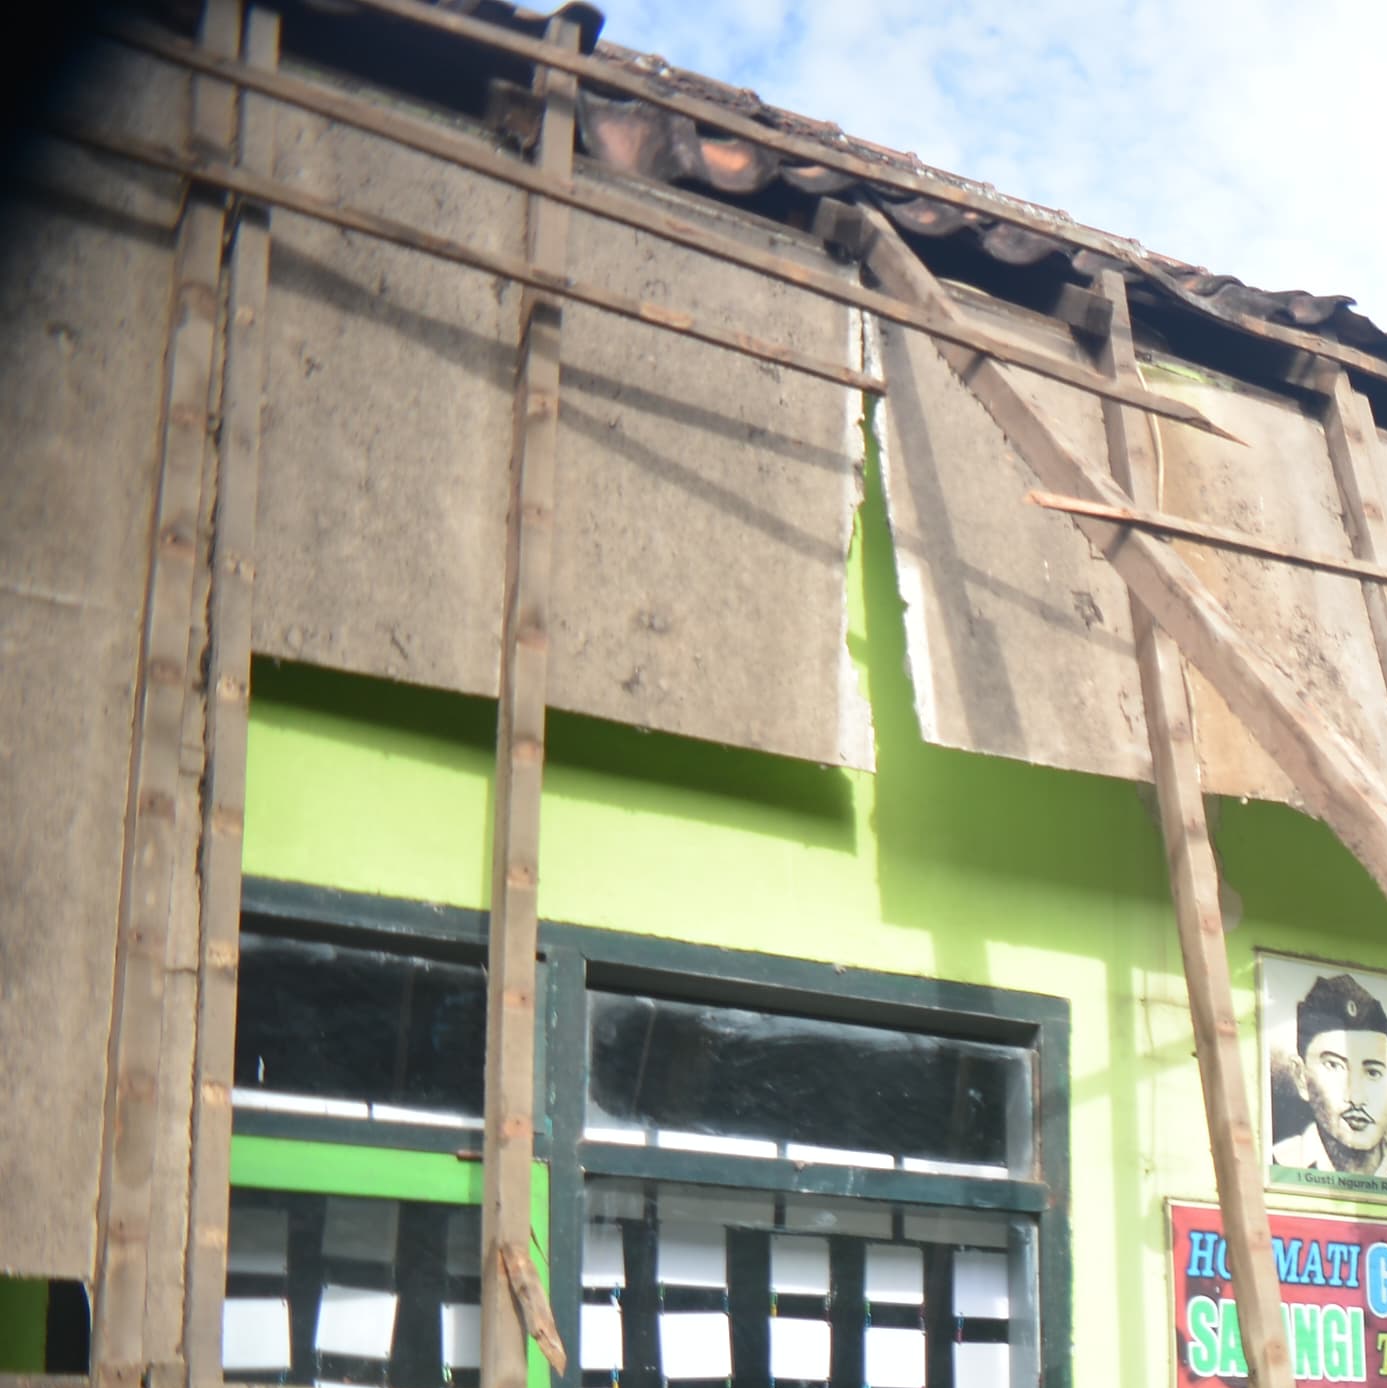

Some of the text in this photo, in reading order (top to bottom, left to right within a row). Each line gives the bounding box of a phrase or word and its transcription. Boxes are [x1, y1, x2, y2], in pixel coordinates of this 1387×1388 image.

[1305, 1172, 1335, 1186] Gusti
[1338, 1177, 1379, 1191] Ngurah
[1186, 1230, 1362, 1288] HOMATI
[1187, 1295, 1367, 1382] SANGI
